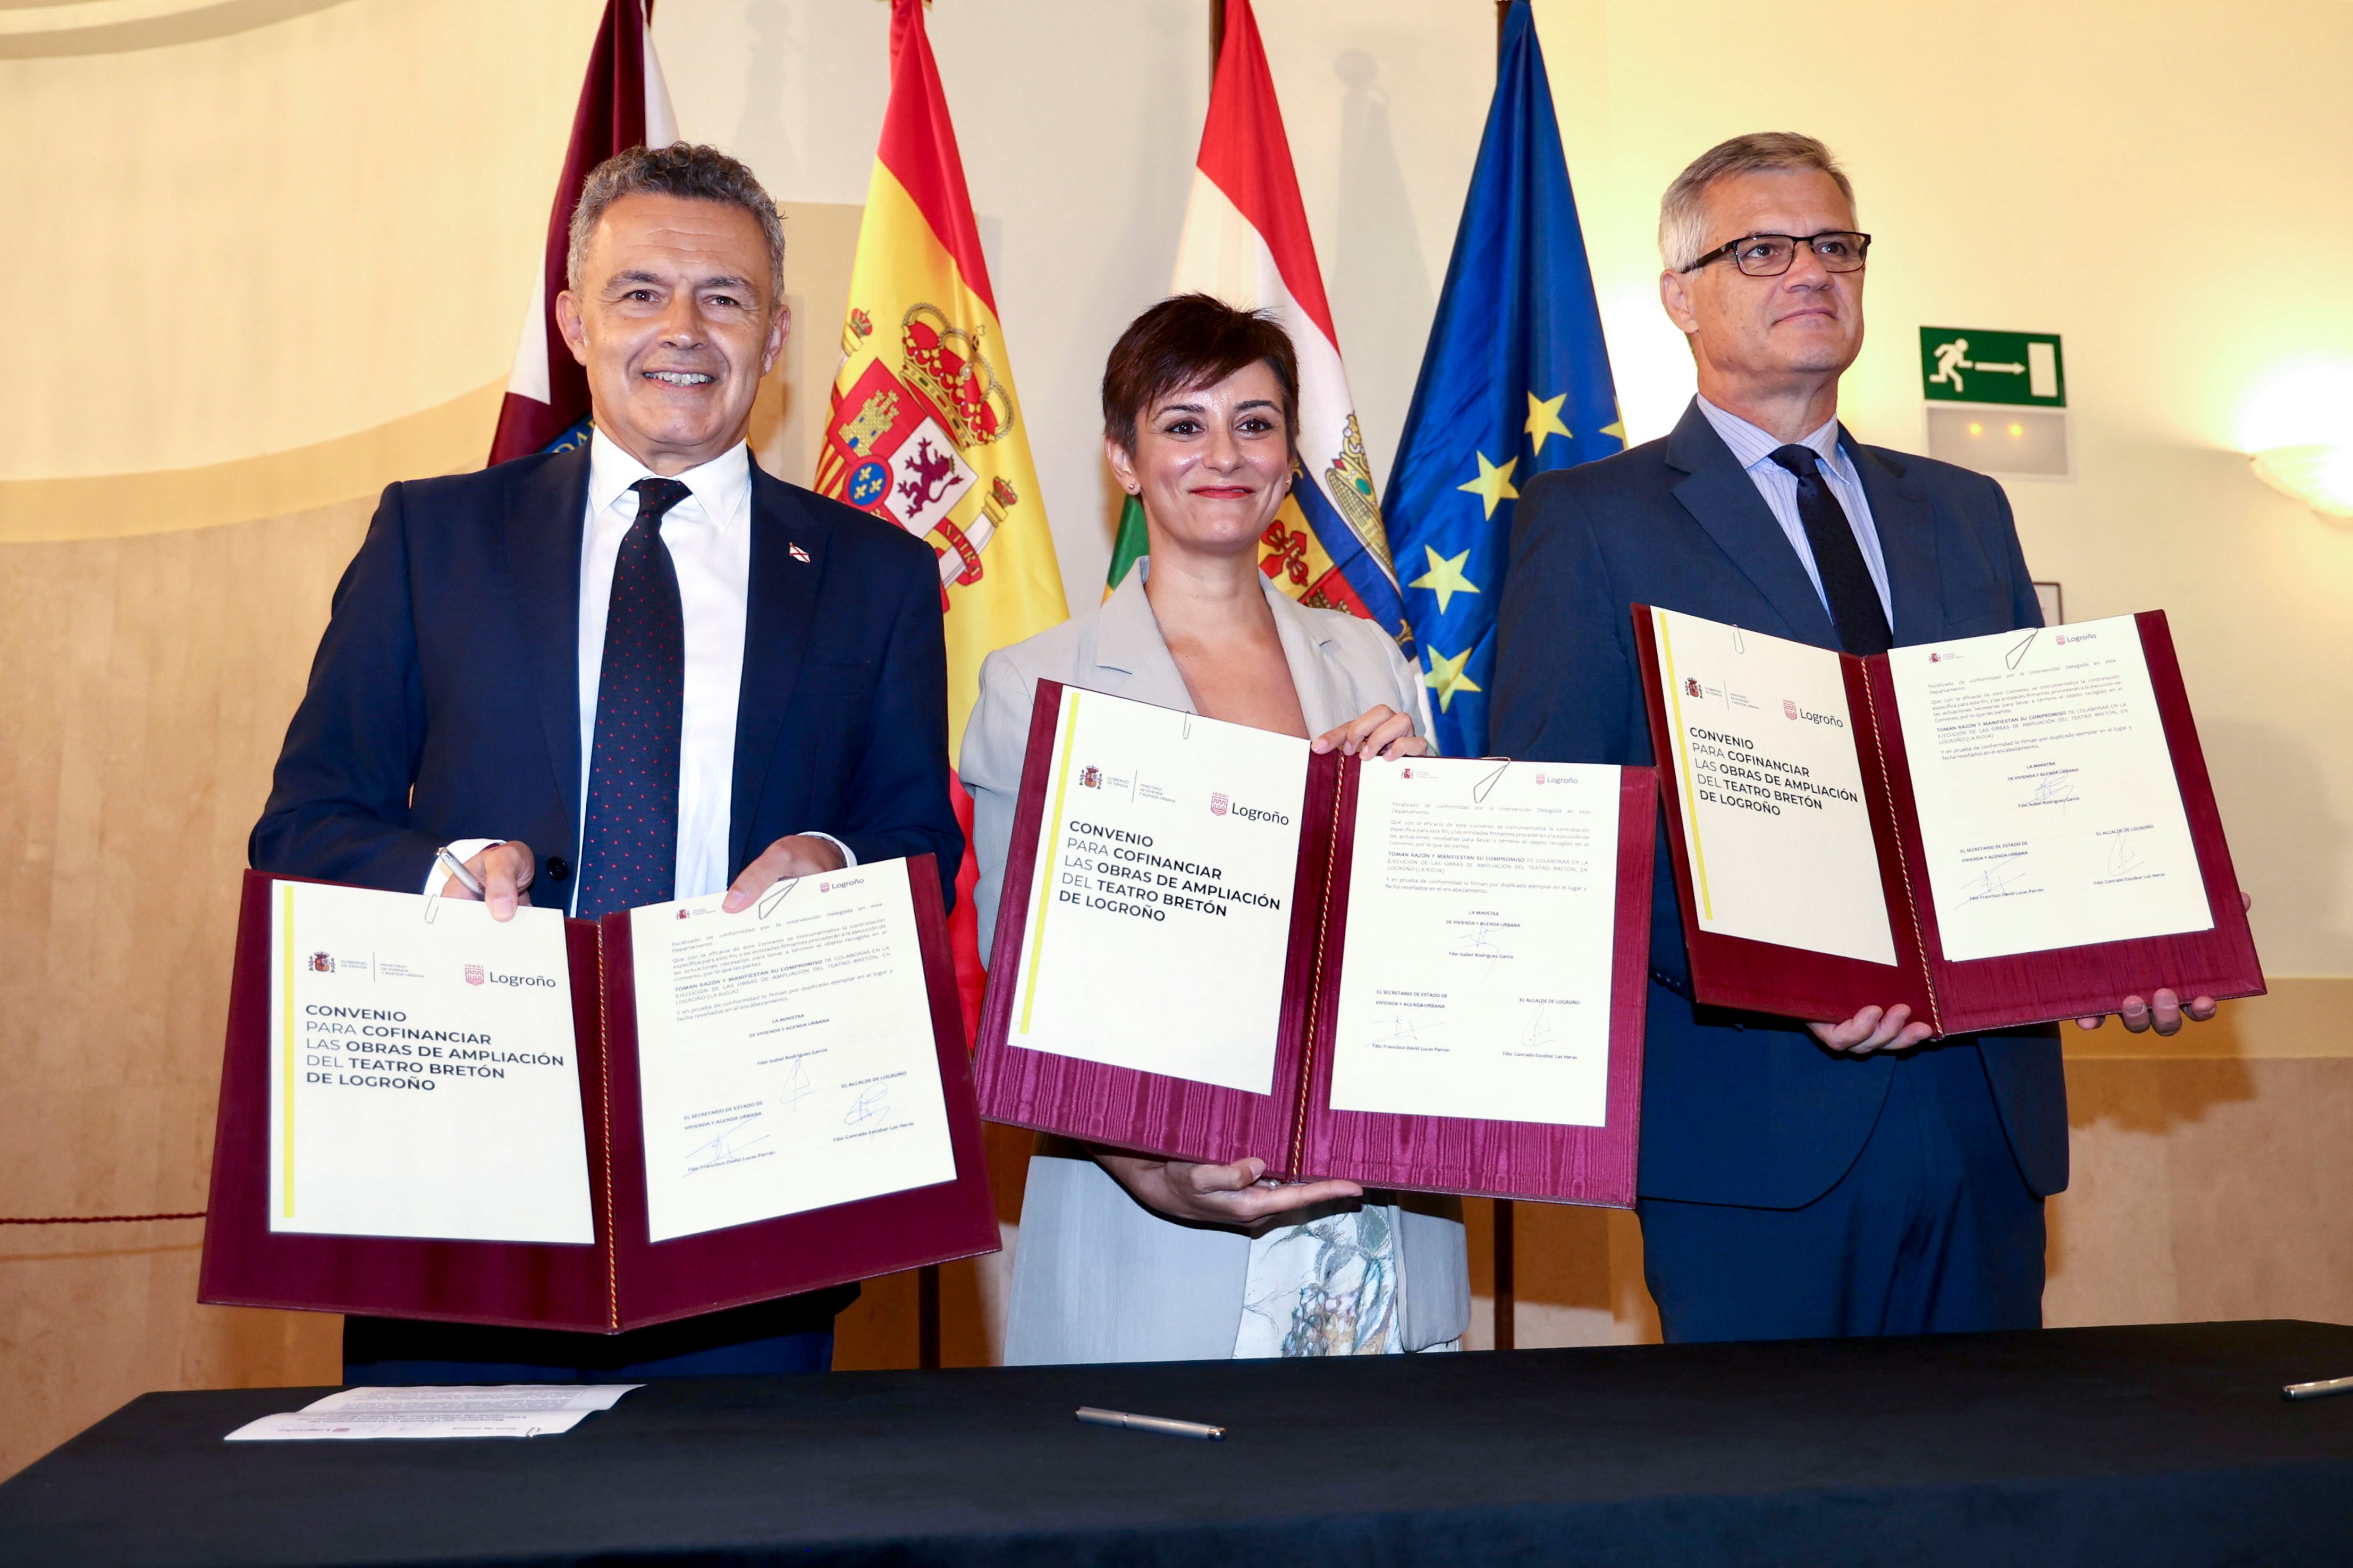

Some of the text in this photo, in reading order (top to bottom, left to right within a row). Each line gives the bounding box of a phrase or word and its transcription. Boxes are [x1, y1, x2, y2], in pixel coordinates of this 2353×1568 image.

[2066, 633, 2096, 642] Logroño
[1799, 708, 1843, 727] Logroño
[2028, 710, 2066, 719] COMPROMISO
[1690, 727, 1753, 749] CONVENIO
[1692, 742, 1810, 777] PARA COFINANCIAR
[1694, 758, 1858, 802] LAS OBRAS DE AMPLIACIÓN
[1697, 773, 1822, 810] DEL TEATRO BRETÓN
[1232, 802, 1289, 825] Logroño
[1699, 789, 1780, 815] DE LOGROÑO
[1069, 820, 1153, 847] CONVENIO
[1067, 837, 1221, 880] PARA COFINANCIAR
[831, 878, 864, 889] Logroño
[1065, 855, 1280, 910] LAS OBRAS DE AMPLIACIÓN
[1059, 889, 1165, 921] DE LOGROÑO
[1062, 872, 1226, 917] DEL TEATRO BRETÓN
[490, 971, 555, 987] Logroño
[728, 970, 769, 981] MANIFIESTAN
[780, 959, 822, 971] COMPROMISO
[306, 1004, 406, 1022] CONVENIO
[307, 1021, 491, 1044] PARA COFINANCIAR
[307, 1038, 563, 1066] LAS OBRAS DE AMPLIACIÓN
[307, 1054, 504, 1078] DEL TEATRO BRETÓN
[307, 1072, 435, 1090] DE LOGROÑO
[848, 1078, 871, 1087] ALCALDE
[880, 1071, 906, 1080] LOGROÑO
[691, 1108, 724, 1118] SECRETARIO
